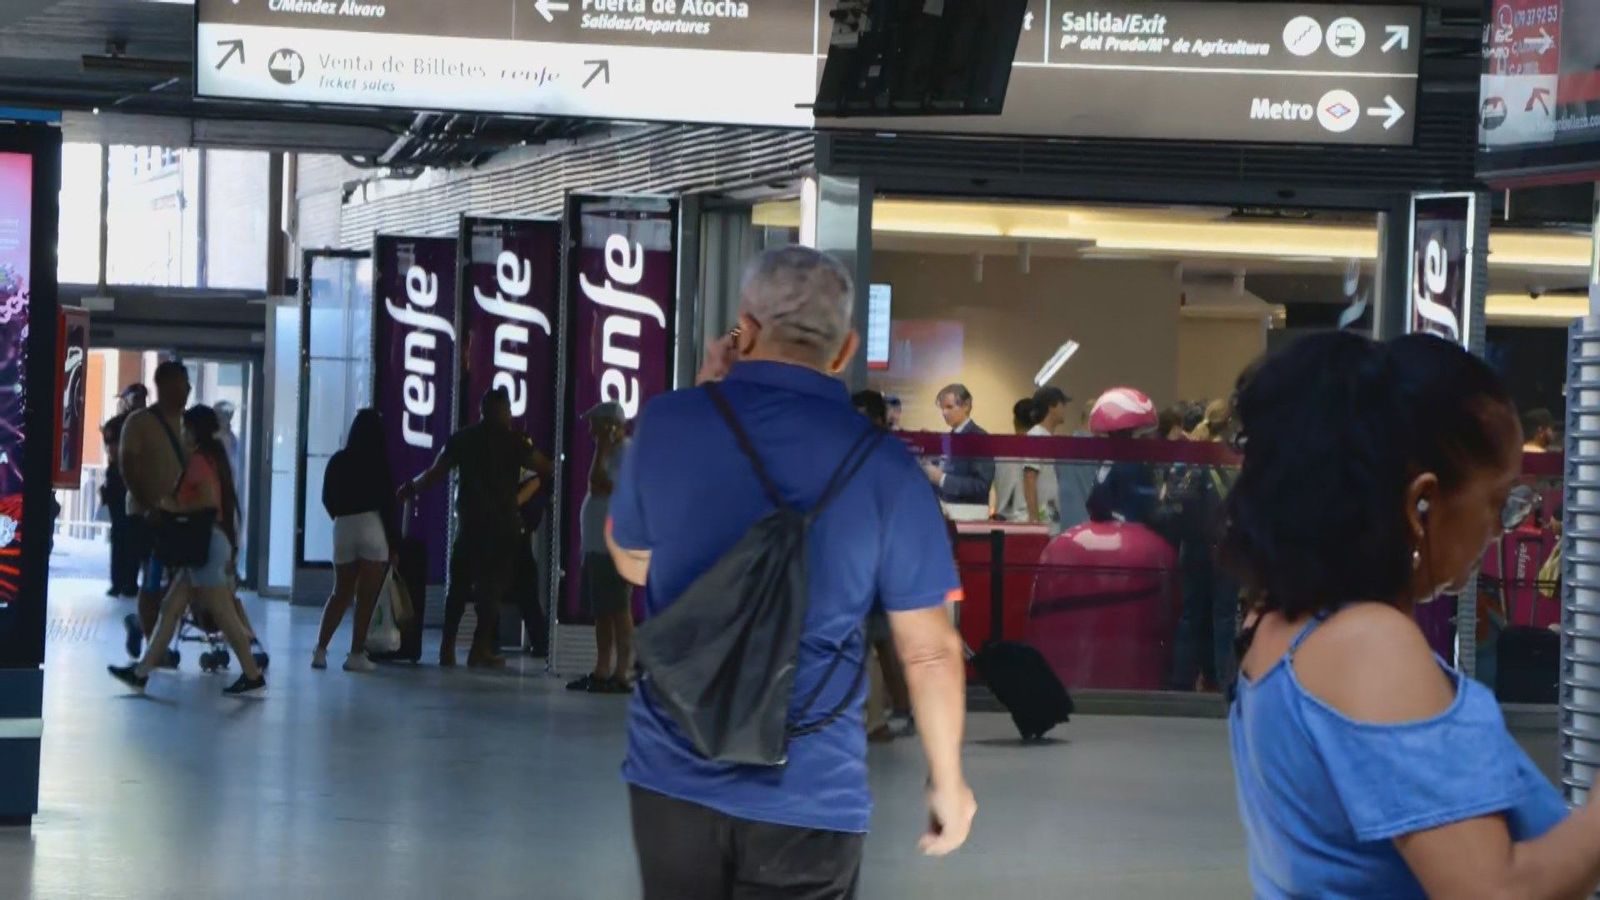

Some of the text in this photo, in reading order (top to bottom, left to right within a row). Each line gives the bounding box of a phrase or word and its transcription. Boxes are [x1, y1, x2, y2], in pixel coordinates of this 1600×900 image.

[652, 0, 675, 14] de
[681, 0, 748, 18] Atocha
[581, 13, 710, 35] Salidas/Departures
[1062, 12, 1166, 34] Salida/Exit
[1080, 35, 1103, 50] del
[1172, 37, 1191, 53] de
[1192, 38, 1270, 57] Agricultura
[319, 53, 373, 72] Venta
[382, 55, 404, 74] de
[413, 57, 487, 77] Billetes
[319, 75, 396, 93] Ticket sales
[1250, 97, 1314, 121] Metro
[474, 250, 551, 418] enfe
[580, 232, 666, 421] enfe
[385, 265, 456, 449] renfe
